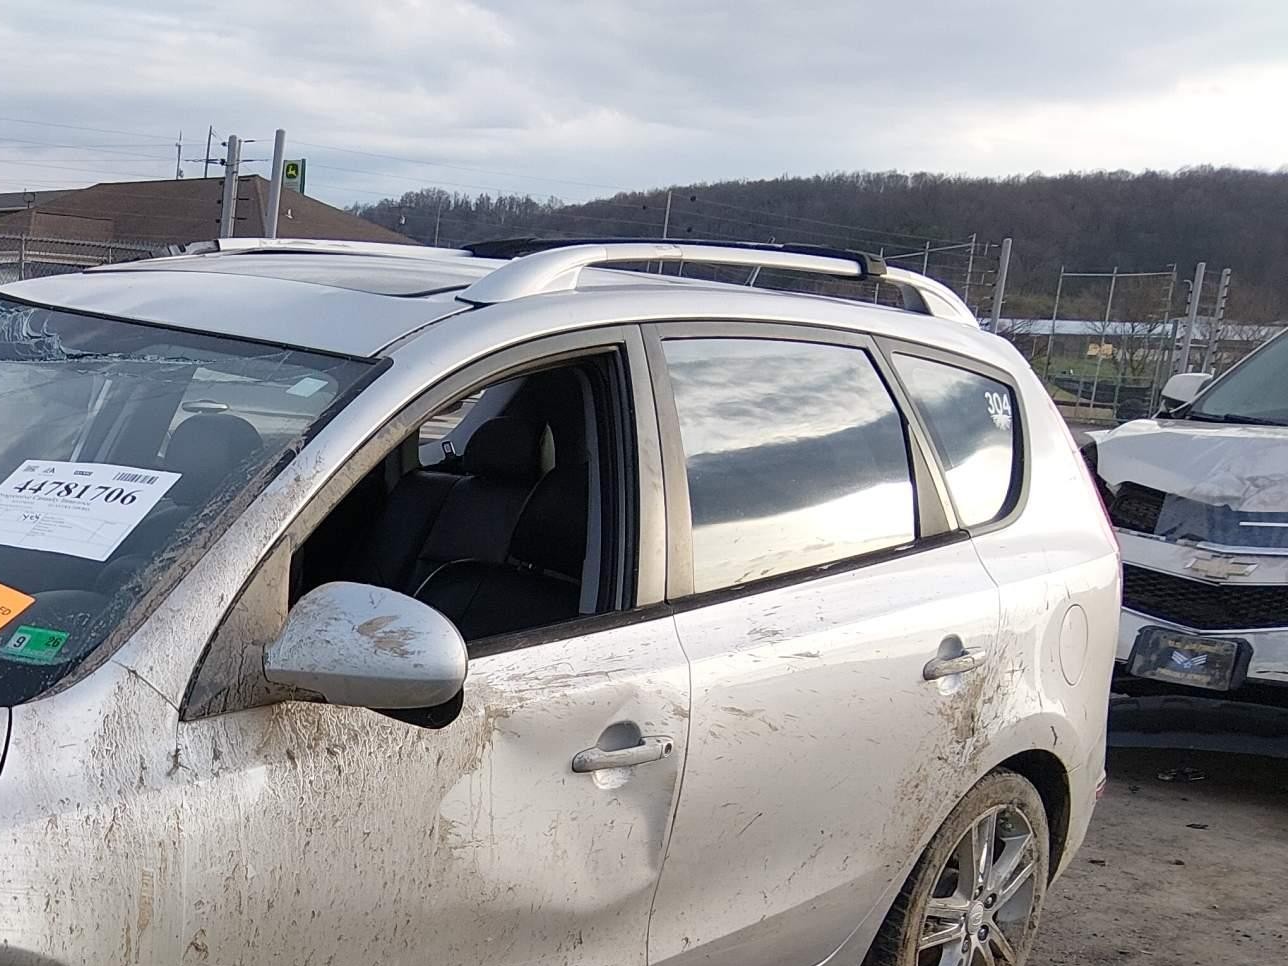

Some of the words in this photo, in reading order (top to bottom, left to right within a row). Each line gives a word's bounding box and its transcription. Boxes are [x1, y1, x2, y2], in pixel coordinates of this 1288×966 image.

[984, 391, 1012, 416] 304
[14, 479, 142, 506] 44781706
[14, 636, 26, 648] 9
[45, 636, 62, 648] 26
